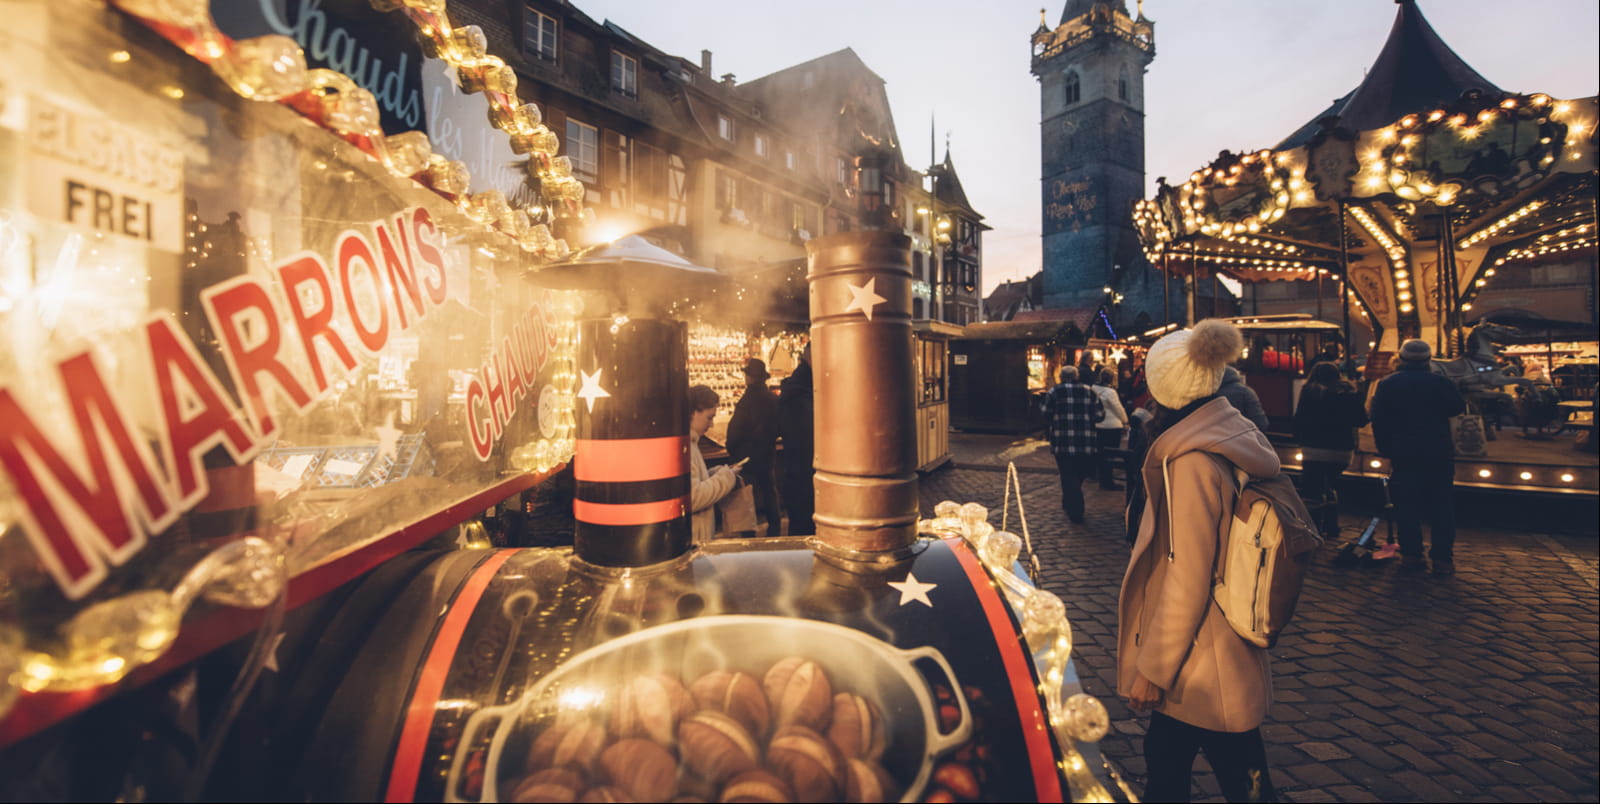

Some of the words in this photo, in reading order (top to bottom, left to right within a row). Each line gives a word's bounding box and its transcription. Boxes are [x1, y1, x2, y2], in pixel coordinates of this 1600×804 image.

[431, 86, 463, 161] les
[65, 178, 152, 241] FREI
[0, 205, 449, 592] MARRONS
[466, 290, 558, 461] CHAUDS
